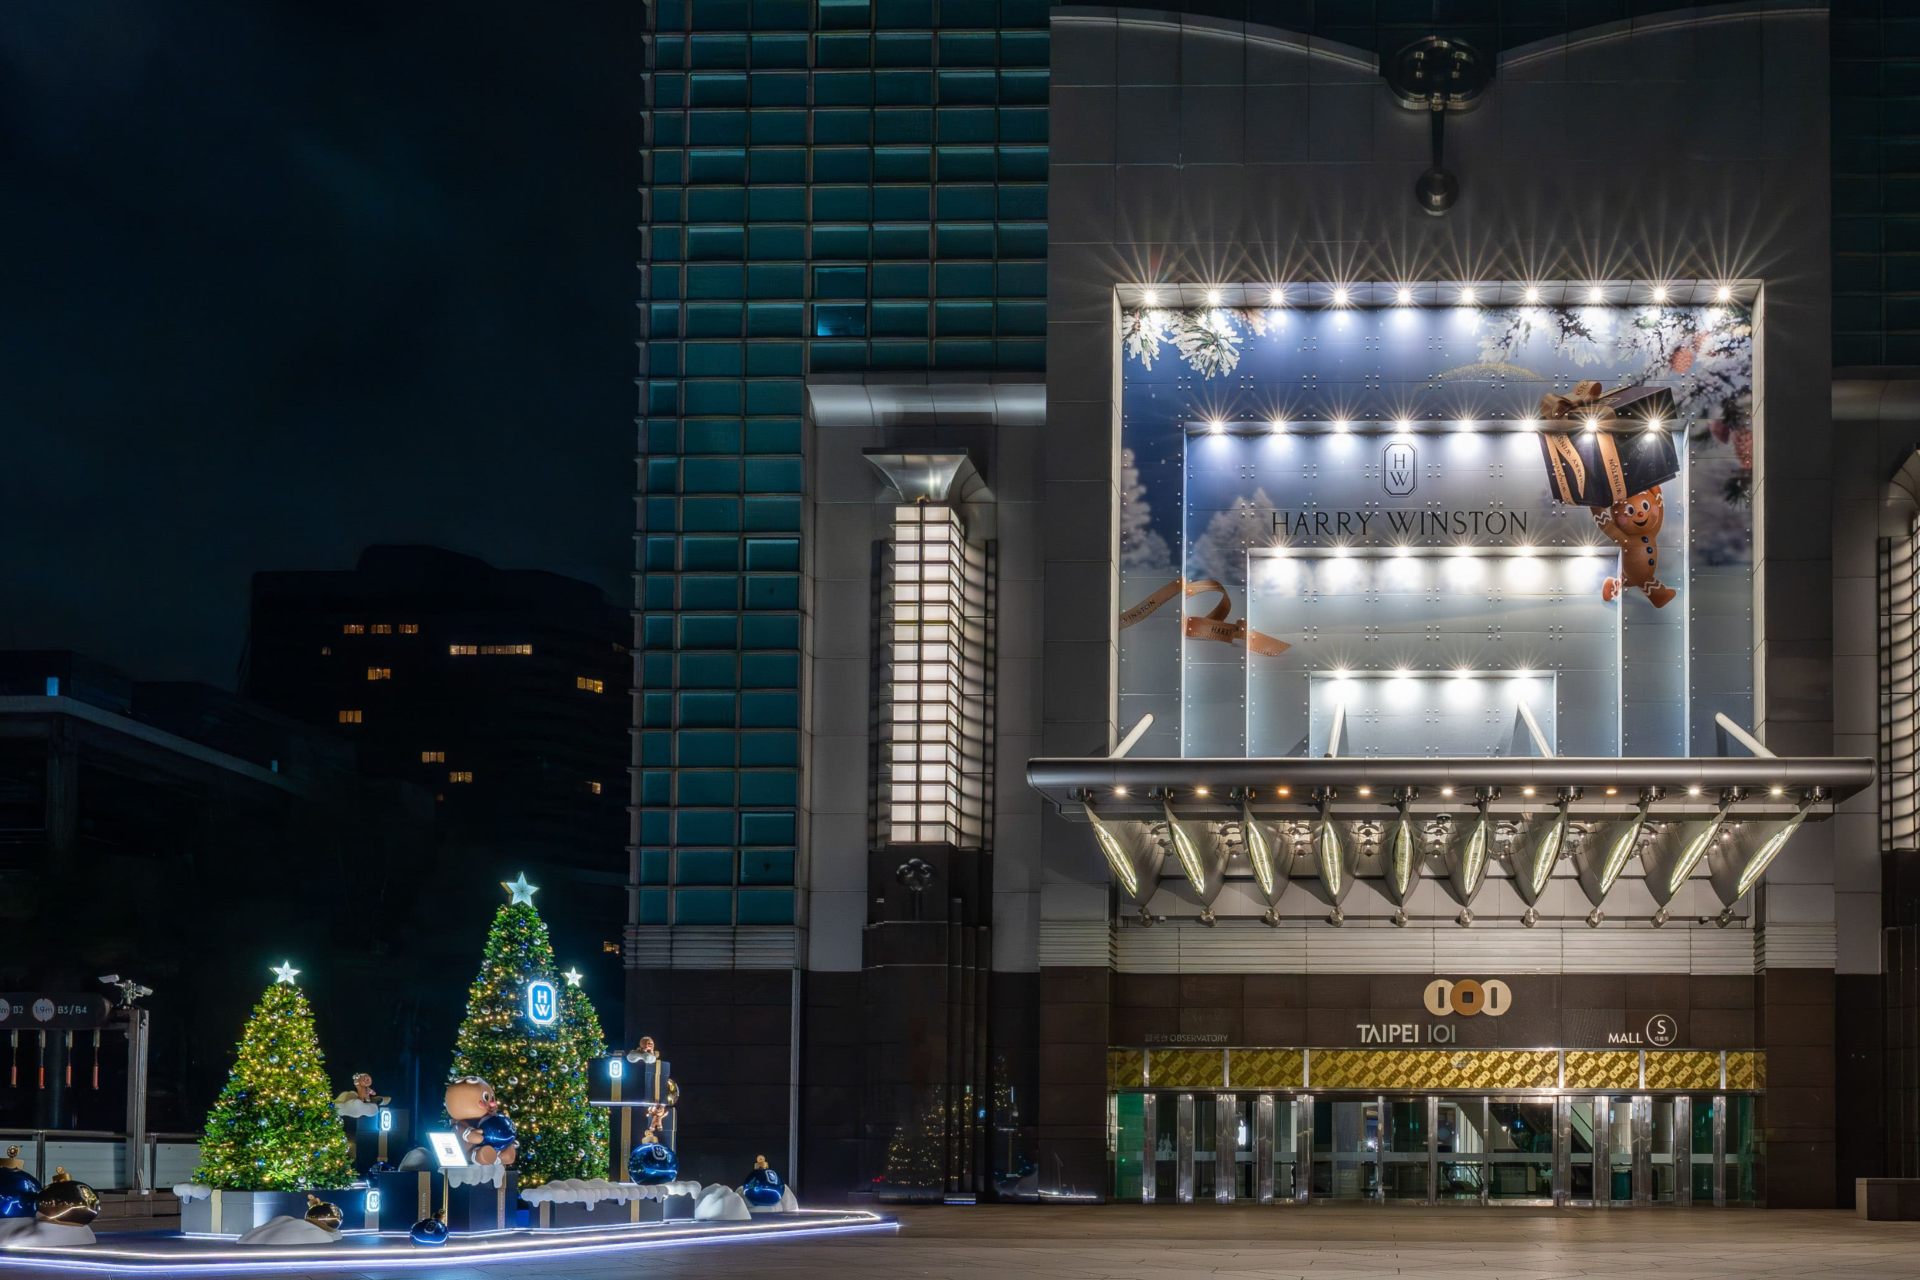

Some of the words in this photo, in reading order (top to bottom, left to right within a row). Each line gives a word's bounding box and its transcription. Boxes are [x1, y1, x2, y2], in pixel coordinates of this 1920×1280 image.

[1609, 458, 1622, 495] WINSTON
[1272, 511, 1374, 536] HARRY
[1386, 511, 1528, 536] WINSTON
[1356, 1024, 1419, 1043] TAIPEI
[1657, 1019, 1666, 1035] S
[1169, 1033, 1228, 1043] OBSERVATORY
[1608, 1032, 1644, 1044] MALL
